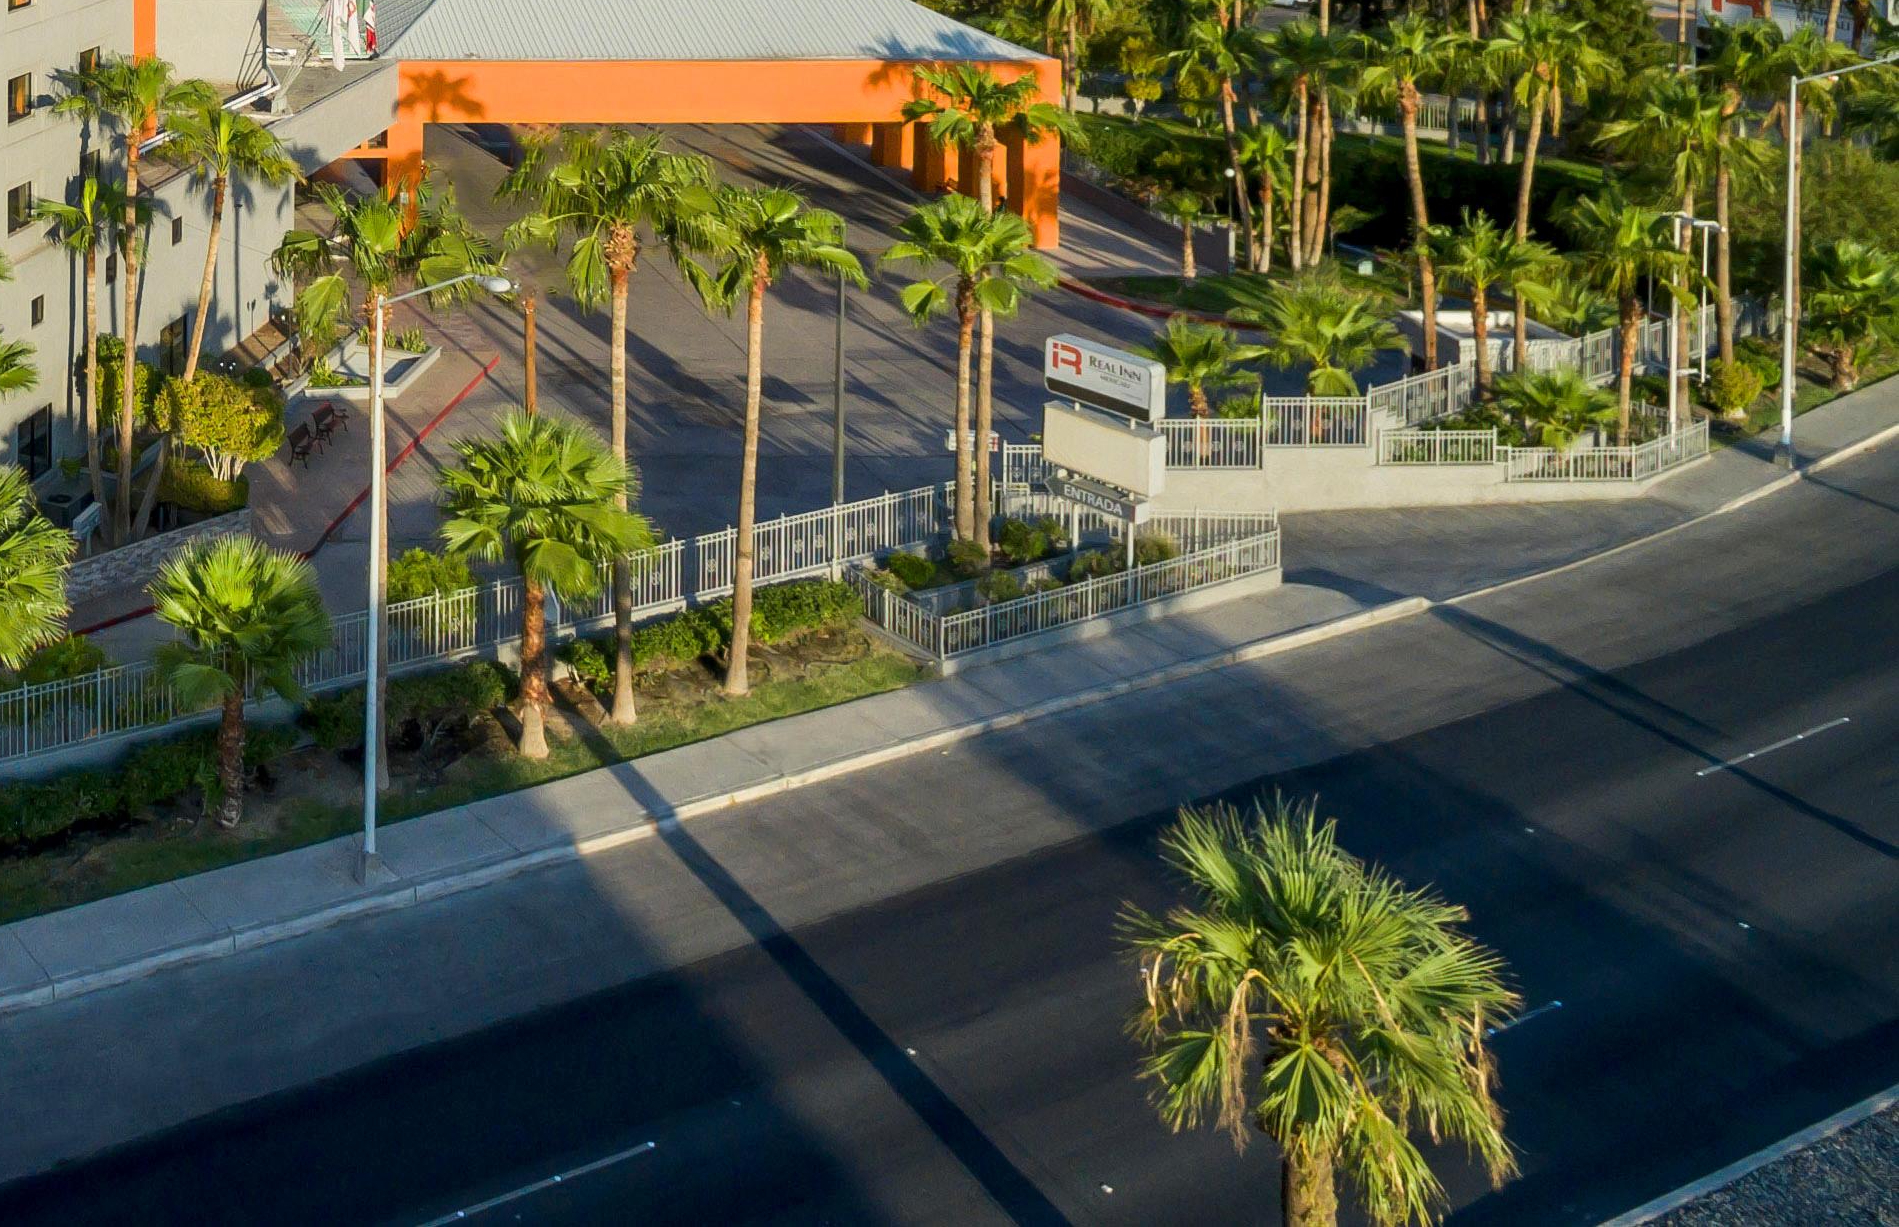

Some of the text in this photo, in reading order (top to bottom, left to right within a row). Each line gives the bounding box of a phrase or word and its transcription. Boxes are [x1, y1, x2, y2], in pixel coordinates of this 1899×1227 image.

[1089, 355, 1141, 382] REAL INN
[1064, 484, 1122, 516] ENTRADA
